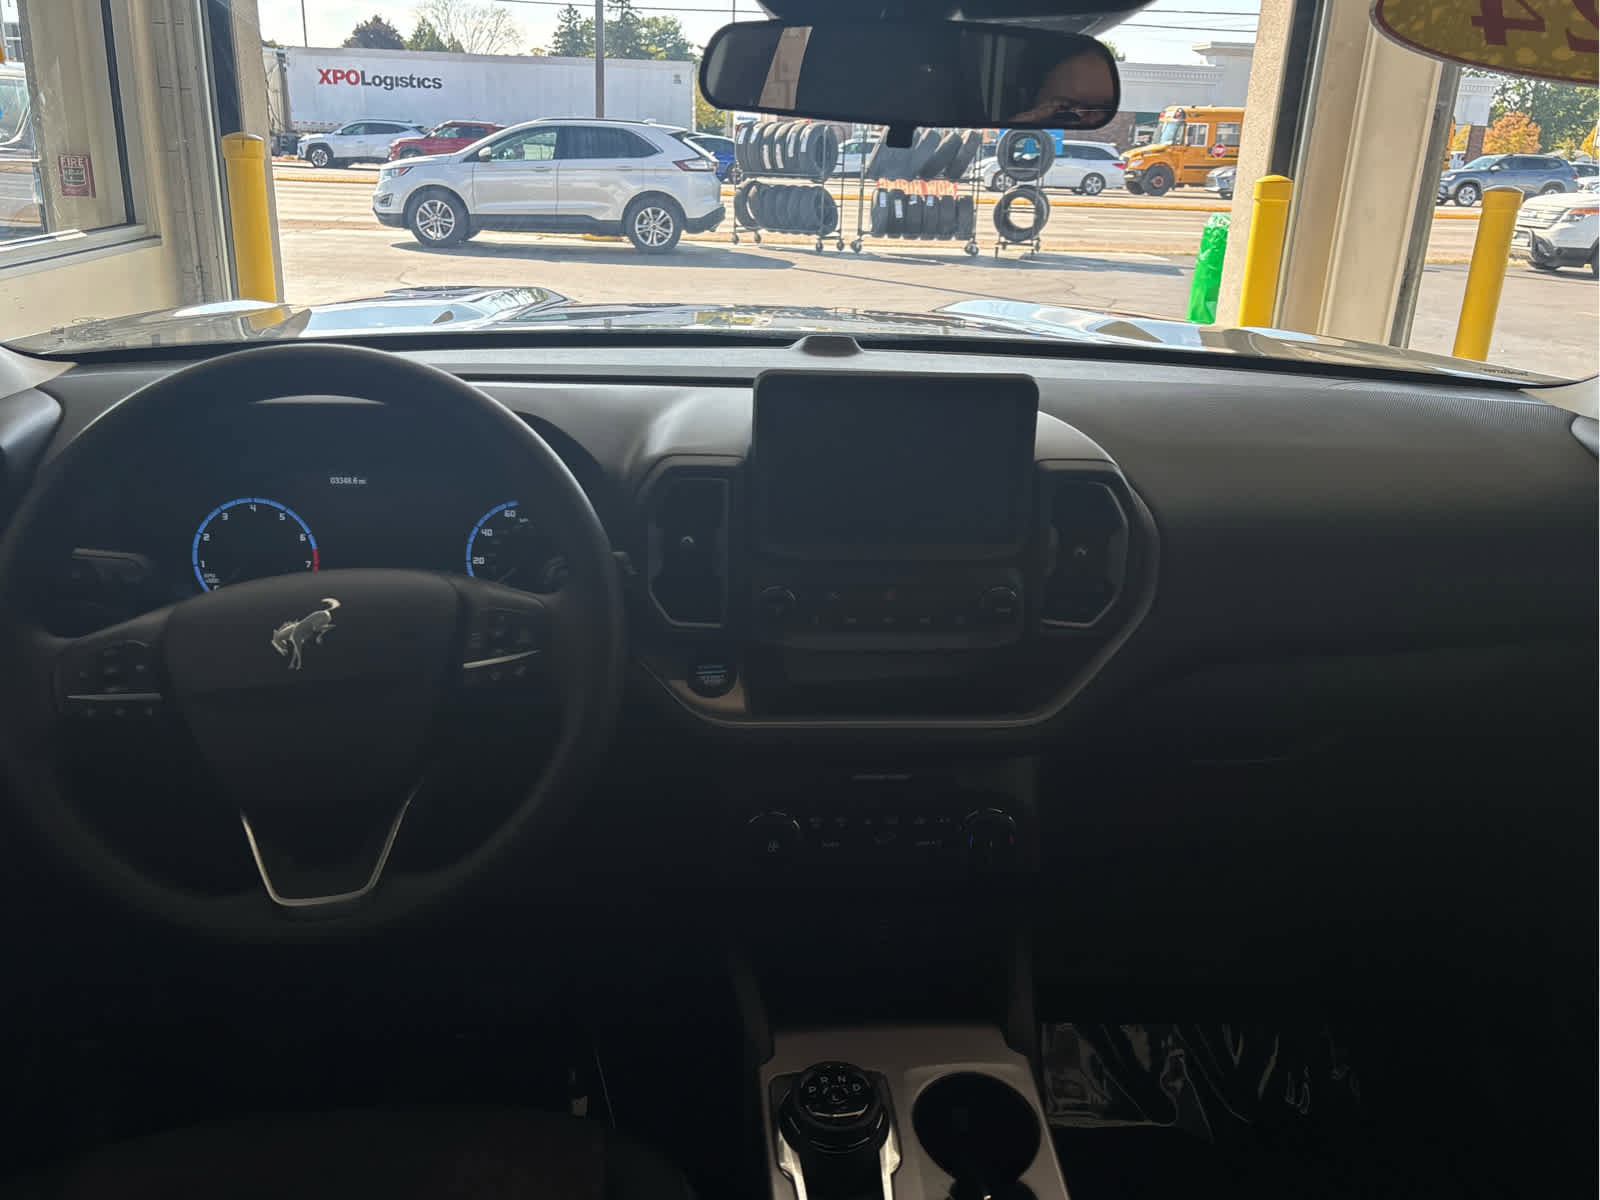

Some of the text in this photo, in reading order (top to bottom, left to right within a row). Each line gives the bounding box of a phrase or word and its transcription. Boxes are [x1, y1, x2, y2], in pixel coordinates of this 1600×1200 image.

[248, 504, 257, 512] 4
[221, 512, 229, 521] 3
[279, 512, 286, 521] 5
[504, 509, 516, 518] 60
[203, 533, 210, 541] 2
[299, 533, 306, 541] 6
[481, 528, 493, 537] 40
[304, 560, 312, 568] 7
[472, 556, 485, 565] 20
[852, 1083, 862, 1092] D
